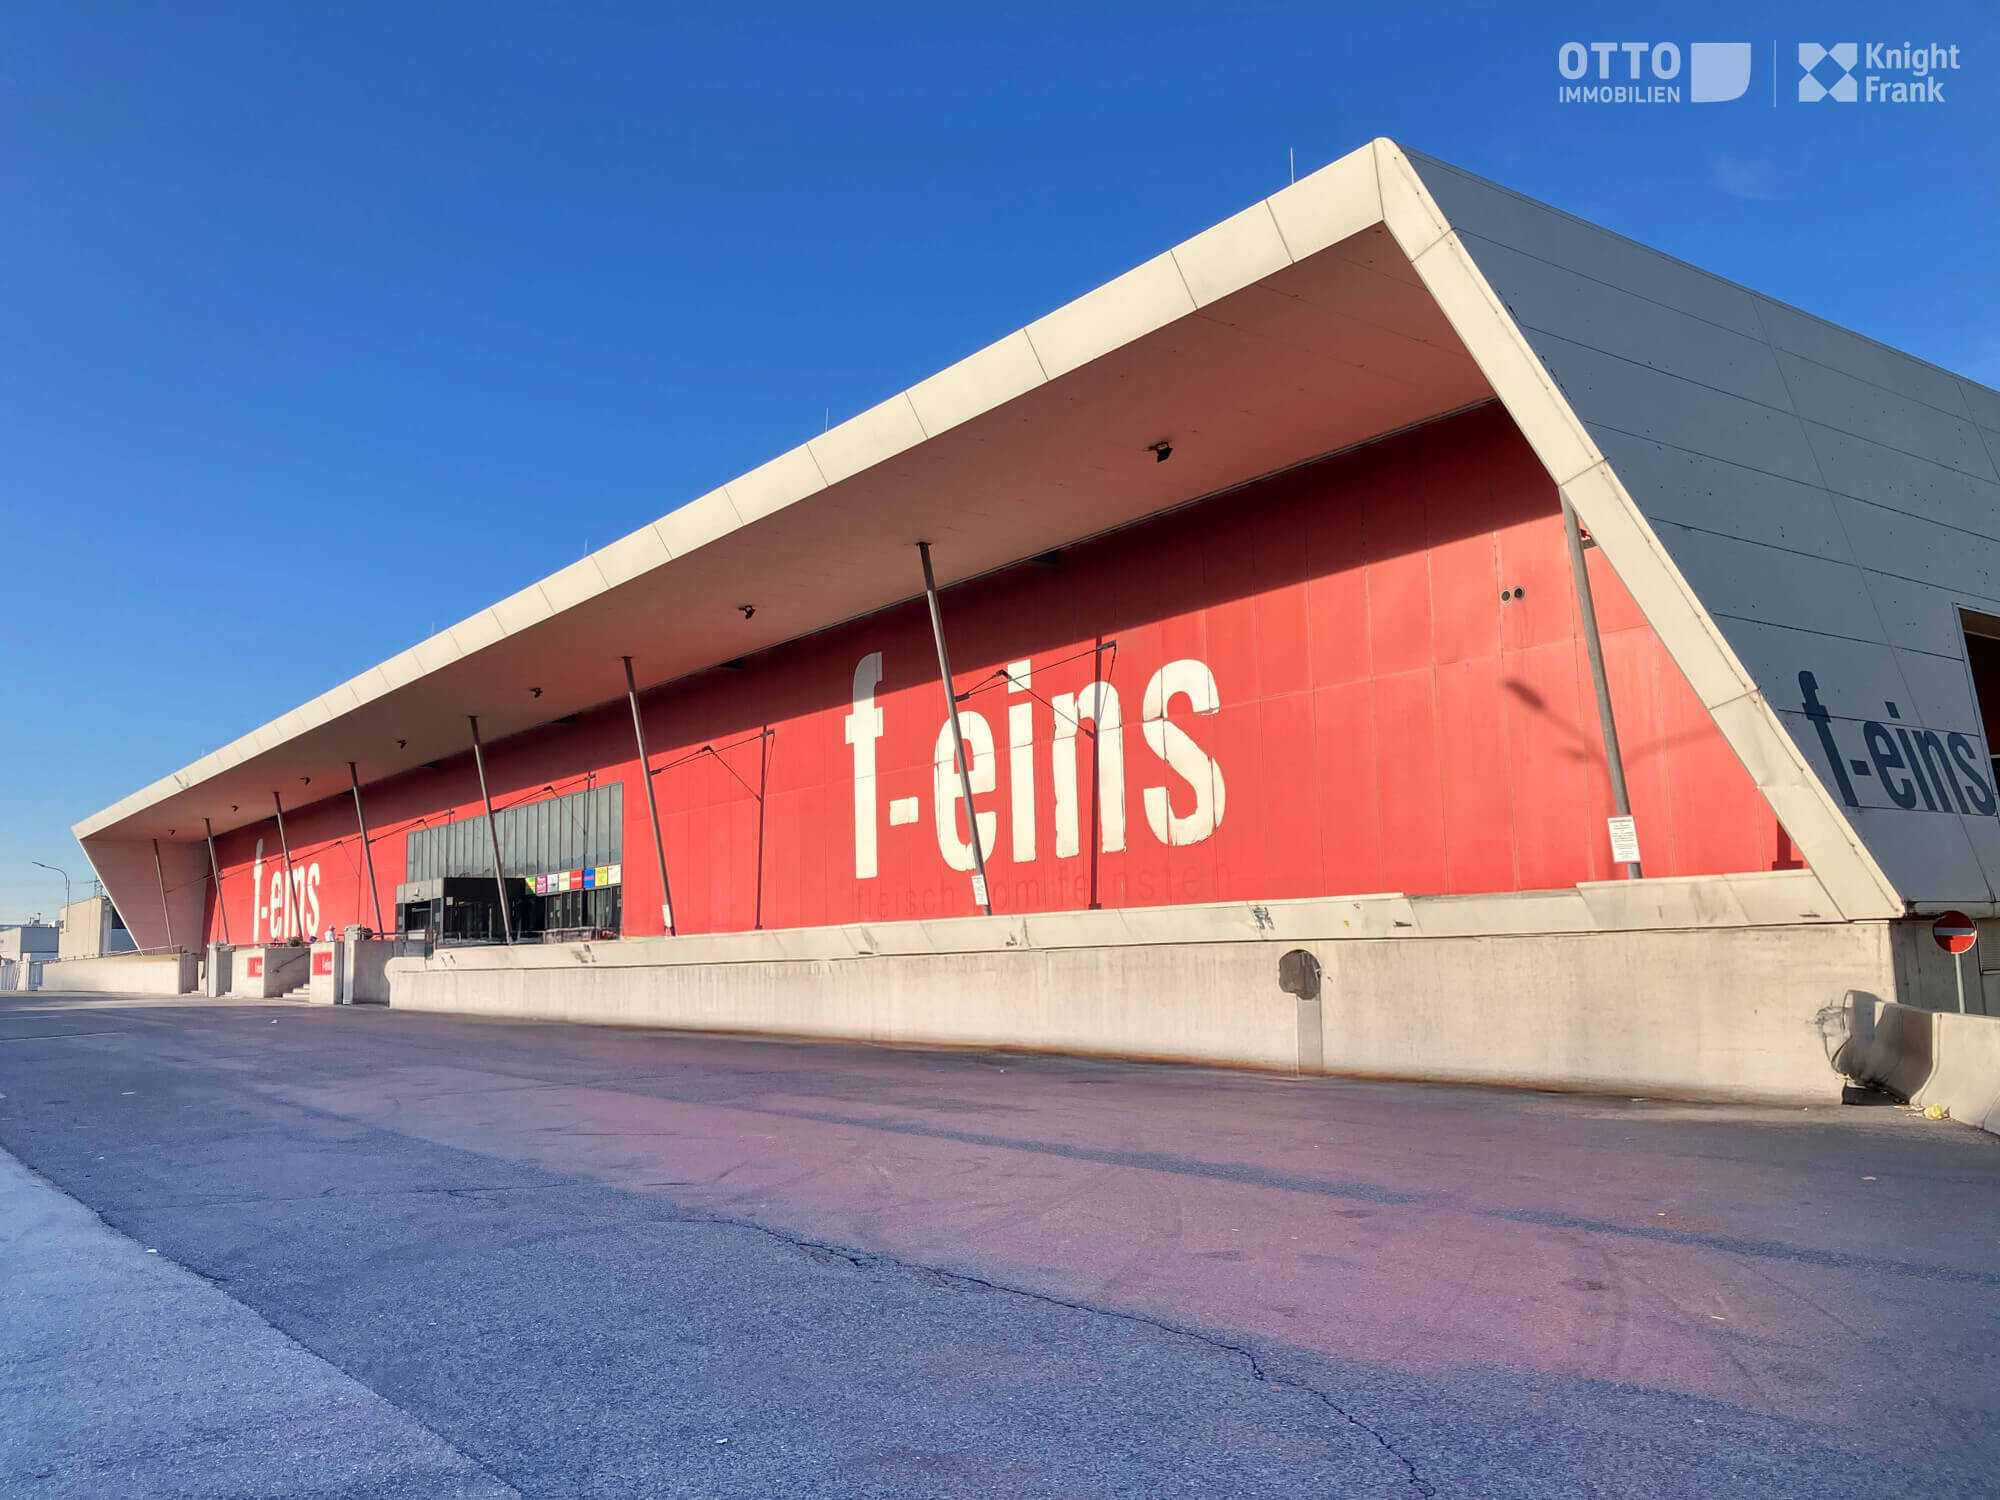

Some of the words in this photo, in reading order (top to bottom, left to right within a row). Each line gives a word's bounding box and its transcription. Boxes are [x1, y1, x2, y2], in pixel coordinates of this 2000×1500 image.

[845, 651, 1226, 879] f-eins
[1797, 670, 1996, 816] f-eins
[253, 838, 320, 944] f-eins
